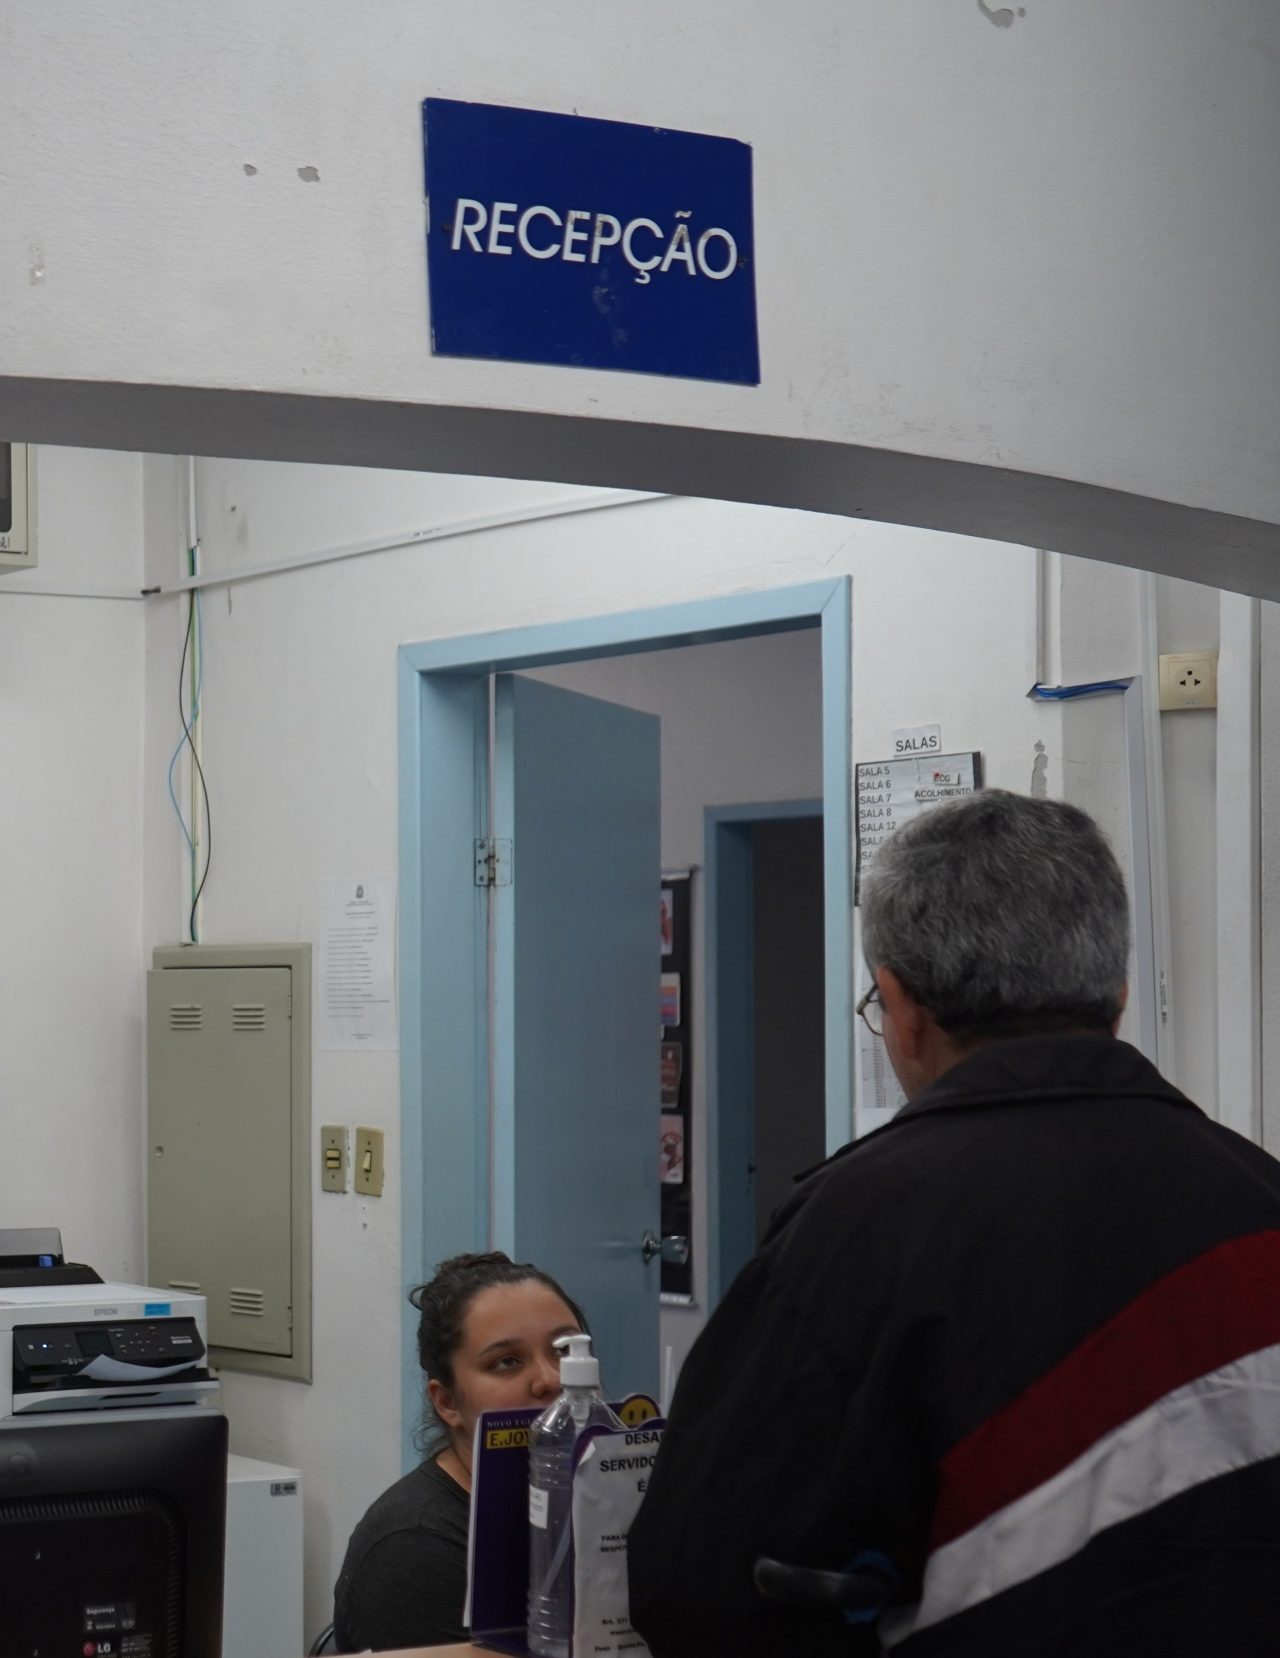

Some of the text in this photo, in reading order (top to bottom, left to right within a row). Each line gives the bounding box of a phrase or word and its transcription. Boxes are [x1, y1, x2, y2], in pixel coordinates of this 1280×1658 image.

[451, 198, 738, 285] RECEPÇÃO
[896, 736, 937, 752] SALAS
[859, 766, 890, 777] SALA 5
[859, 780, 891, 791] SALA 6
[860, 794, 891, 805] SALA 7
[914, 788, 971, 799] ACOLHIMENTO
[860, 807, 892, 819] SALA 8
[860, 821, 896, 833] SALA 12
[600, 1455, 657, 1473] SERVIDO
[97, 1642, 111, 1654] LG
